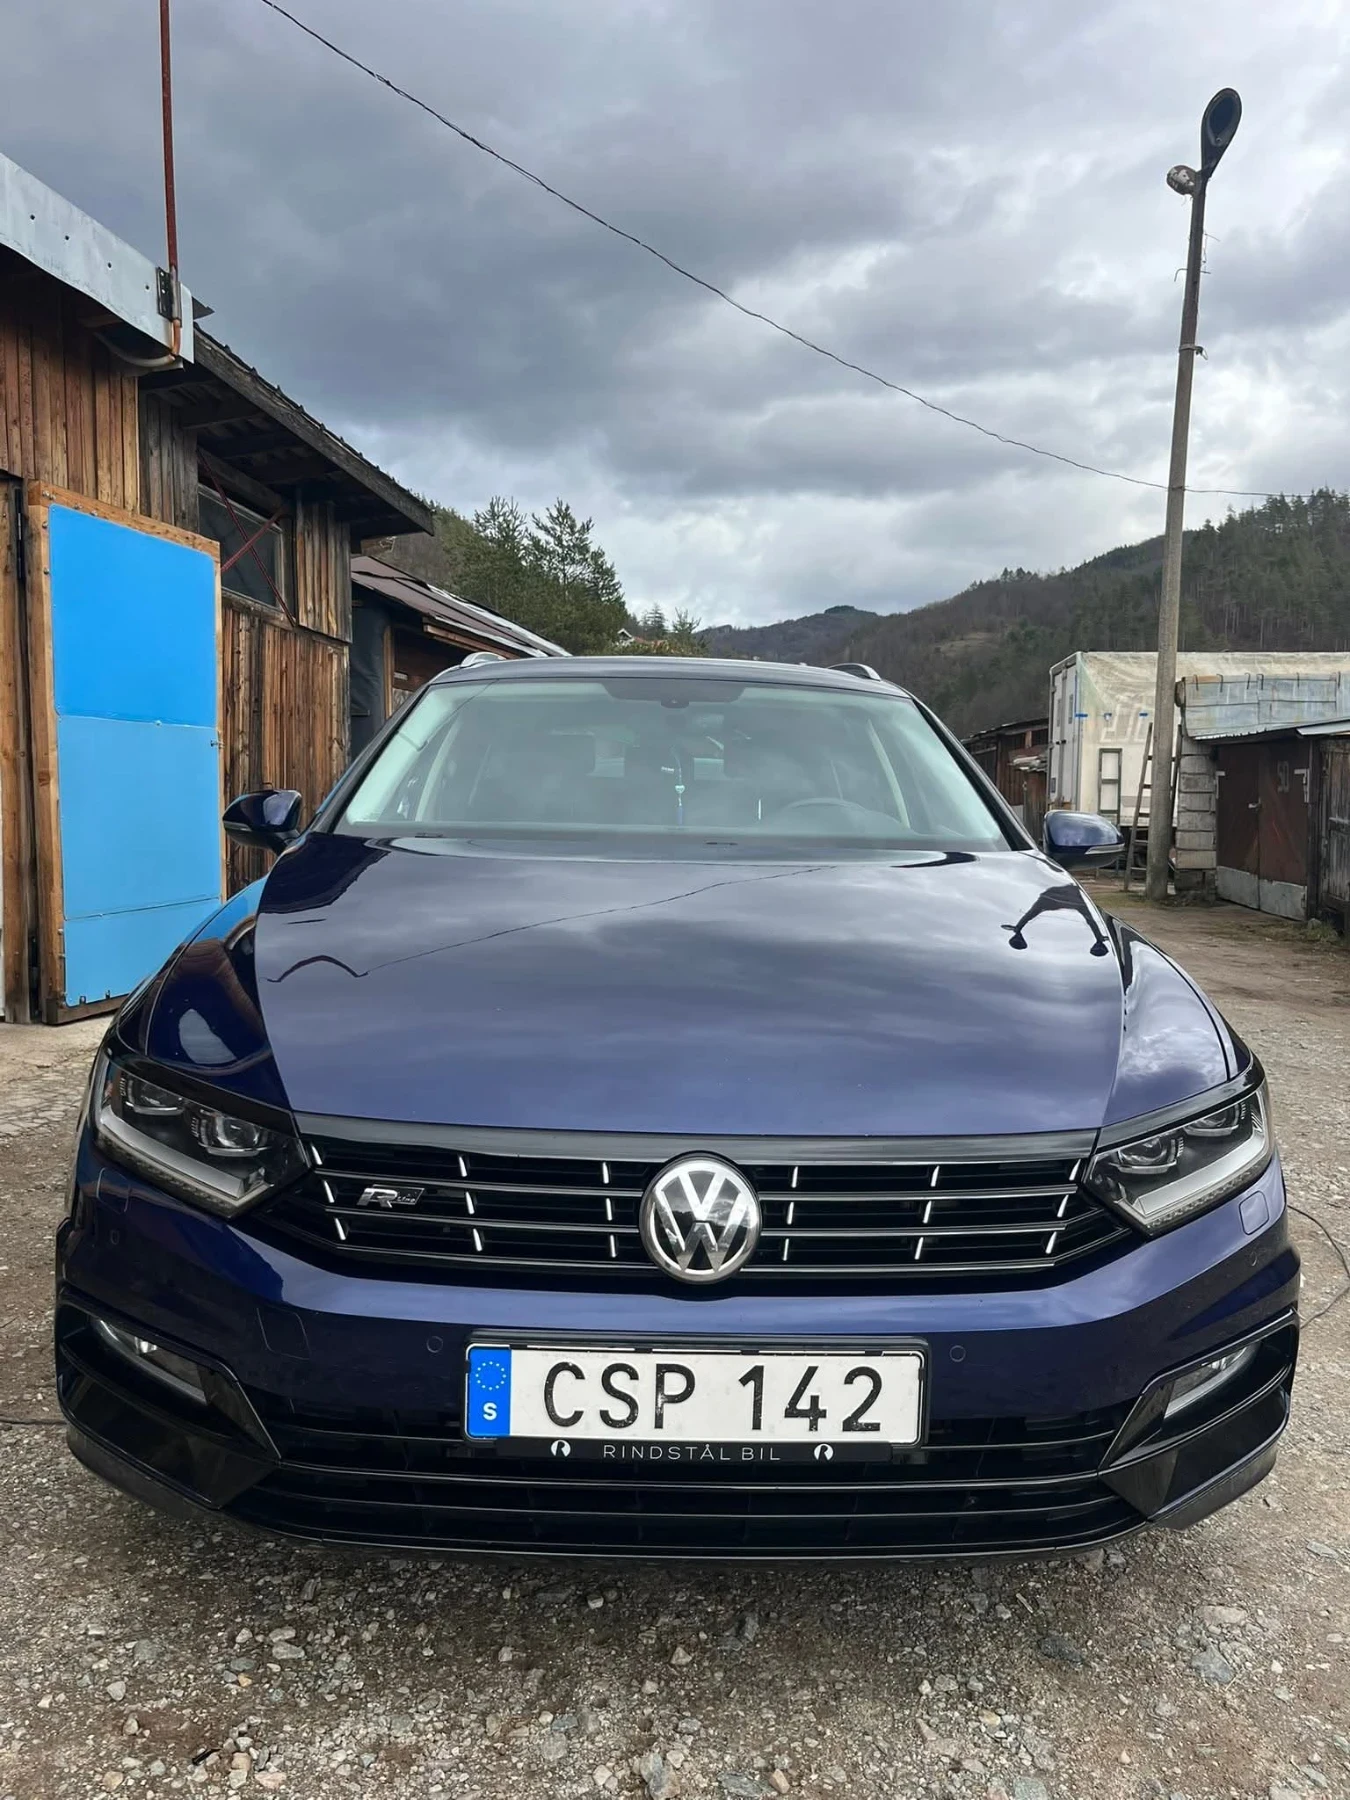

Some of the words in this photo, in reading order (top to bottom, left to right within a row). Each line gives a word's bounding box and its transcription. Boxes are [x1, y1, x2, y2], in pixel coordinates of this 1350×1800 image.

[543, 1361, 696, 1429] CSP
[738, 1365, 883, 1432] 142
[482, 1402, 498, 1421] S
[602, 1443, 732, 1461] RINDSTÅL
[741, 1446, 781, 1461] BIL
